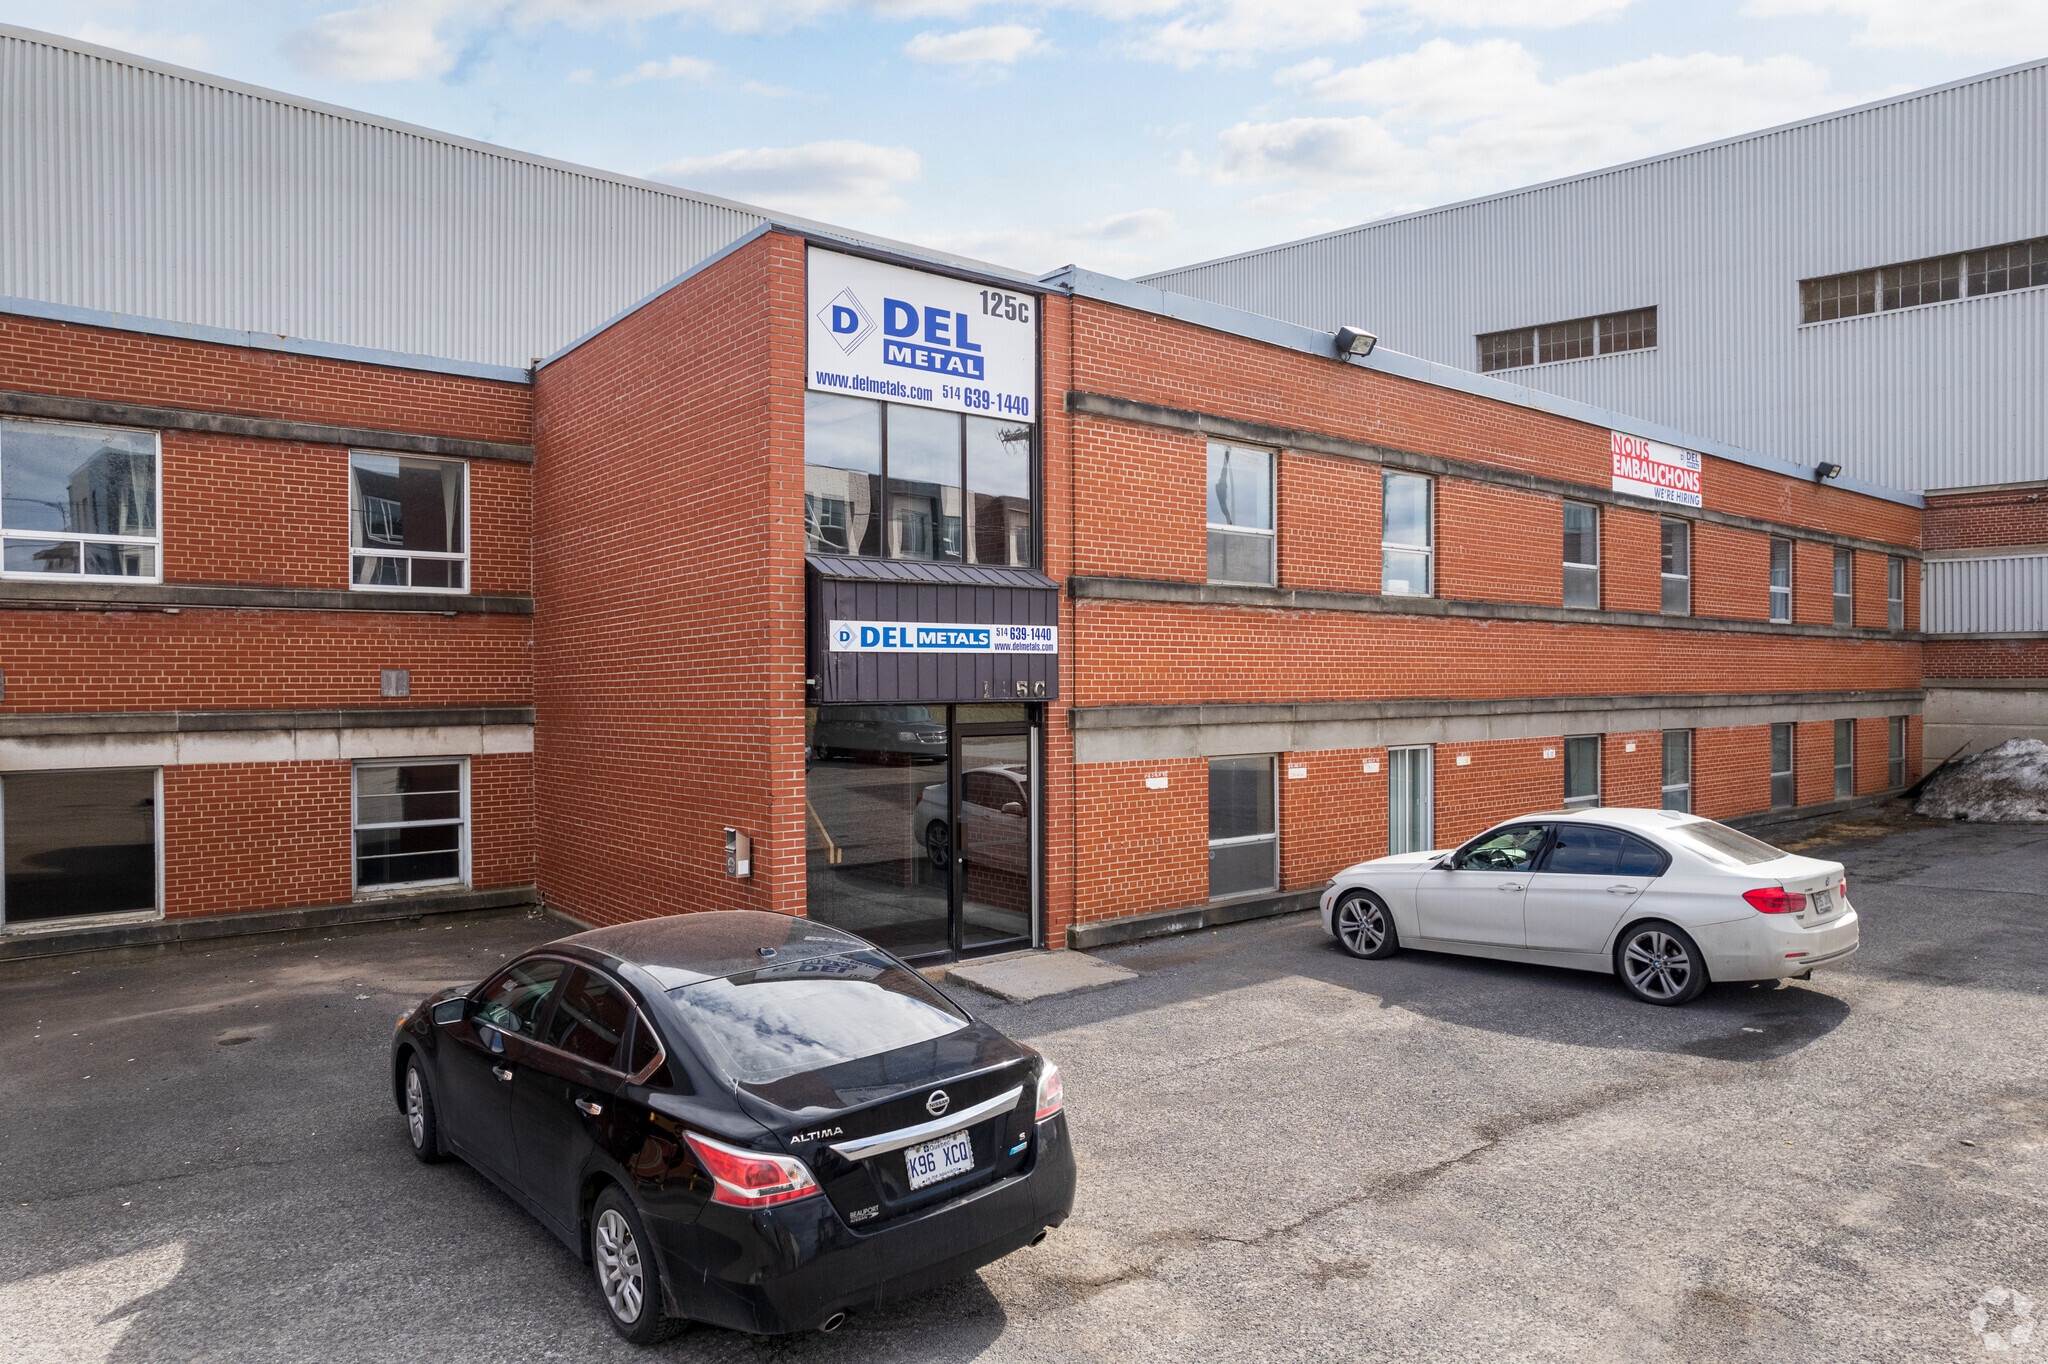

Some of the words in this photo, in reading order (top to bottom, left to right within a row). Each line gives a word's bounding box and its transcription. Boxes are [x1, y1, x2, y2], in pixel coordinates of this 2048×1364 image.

[832, 305, 859, 334] D
[883, 297, 982, 352] DEL
[888, 345, 980, 376] METAL
[816, 371, 933, 402] www.delmetals.com
[942, 385, 961, 400] 514
[964, 387, 1029, 416] 639-1440
[1613, 434, 1650, 459] NOUS
[1687, 452, 1699, 463] DEL
[1613, 453, 1700, 492] EMBAUCHONS
[1654, 486, 1674, 501] WE'RE
[1676, 491, 1700, 506] HIRING
[839, 631, 850, 642] D
[860, 626, 914, 648] DEL
[918, 631, 989, 646] METALS
[996, 627, 1008, 637] 514
[1010, 627, 1052, 642] 639-1440
[994, 642, 1054, 652] www.delmetals.com
[983, 680, 1045, 698] 15C
[929, 1098, 948, 1108] NISSAN
[790, 1126, 844, 1145] ALTIMA
[910, 1152, 936, 1178] K96
[943, 1141, 968, 1167] XCQ
[850, 1205, 879, 1218] BEAUPORT
